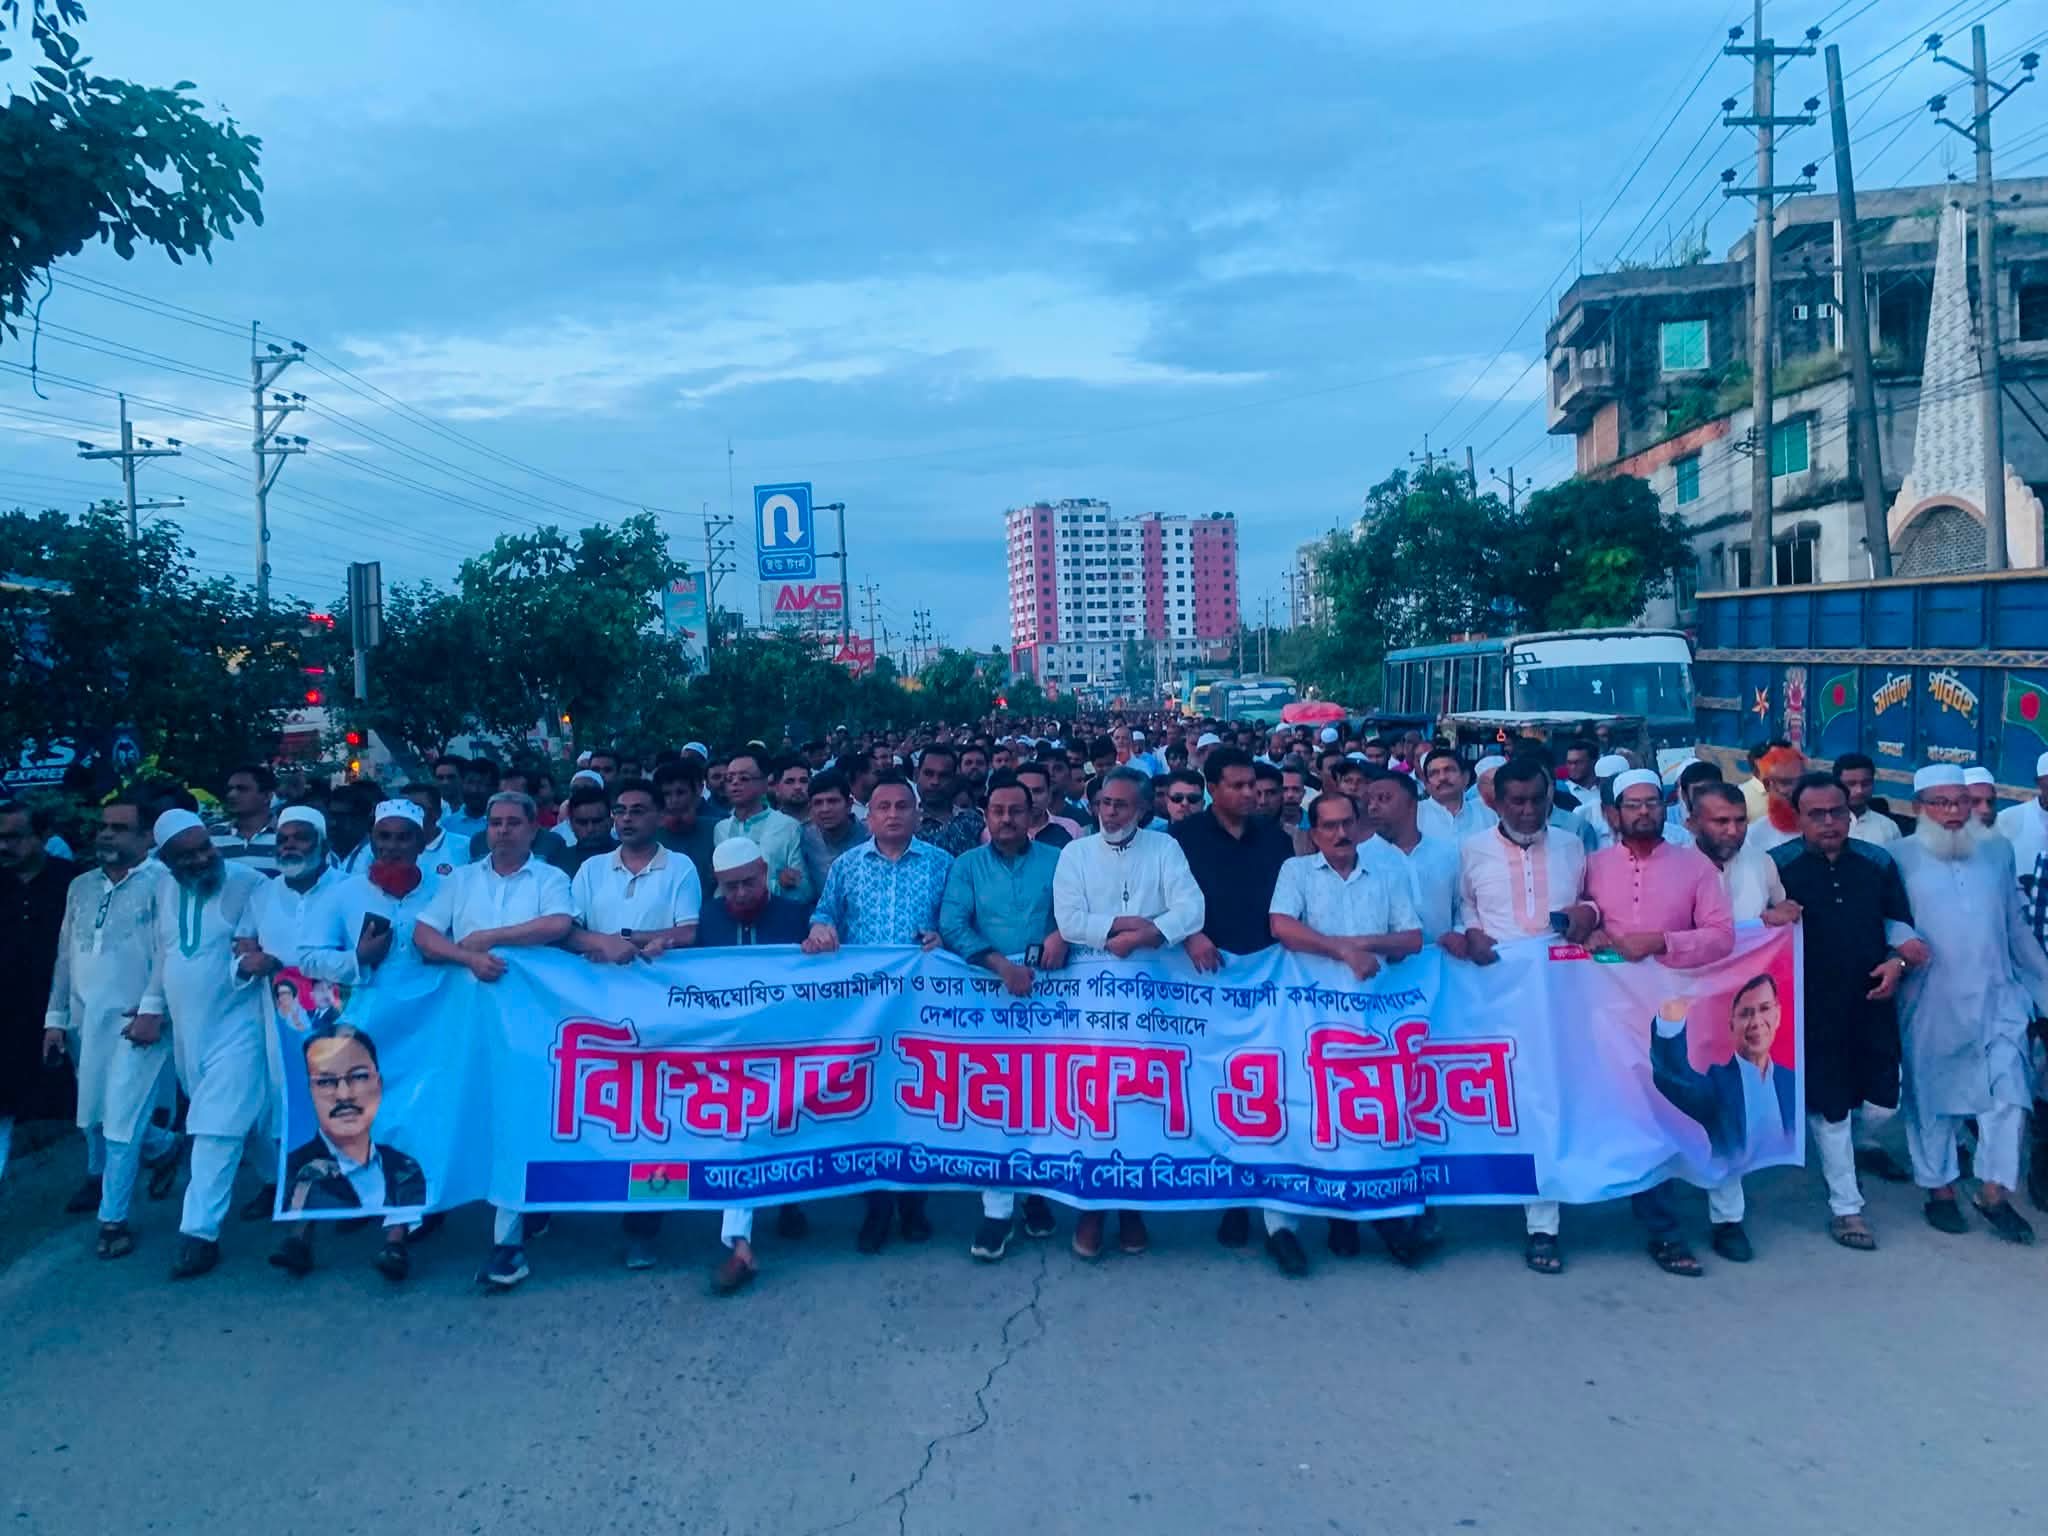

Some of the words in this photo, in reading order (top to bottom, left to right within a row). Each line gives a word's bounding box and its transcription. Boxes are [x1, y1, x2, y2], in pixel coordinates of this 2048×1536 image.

[775, 584, 842, 610] AKS
[667, 980, 786, 1010] নিষিদ্ধঘোষিত
[792, 970, 905, 1002] আওয়ামীলীগ
[911, 976, 926, 993] ও
[930, 975, 964, 997] তার
[1087, 968, 1216, 1006] পরিকল্পিতভাবে
[920, 1003, 985, 1029] দেশকে
[1085, 1009, 1129, 1032] করার
[1136, 1007, 1209, 1037] প্রতিবাদে
[551, 1018, 879, 1142] বিক্ষোভ
[894, 1034, 1191, 1140] সমাবেশ
[1212, 1046, 1287, 1145] ও
[831, 1147, 904, 1177] ভালুকা
[909, 1143, 1000, 1180] উপজেলা
[1091, 1149, 1144, 1189] পৌর
[1150, 1154, 1233, 1188] বিএনপি
[1350, 1168, 1419, 1200] সহযোগী
